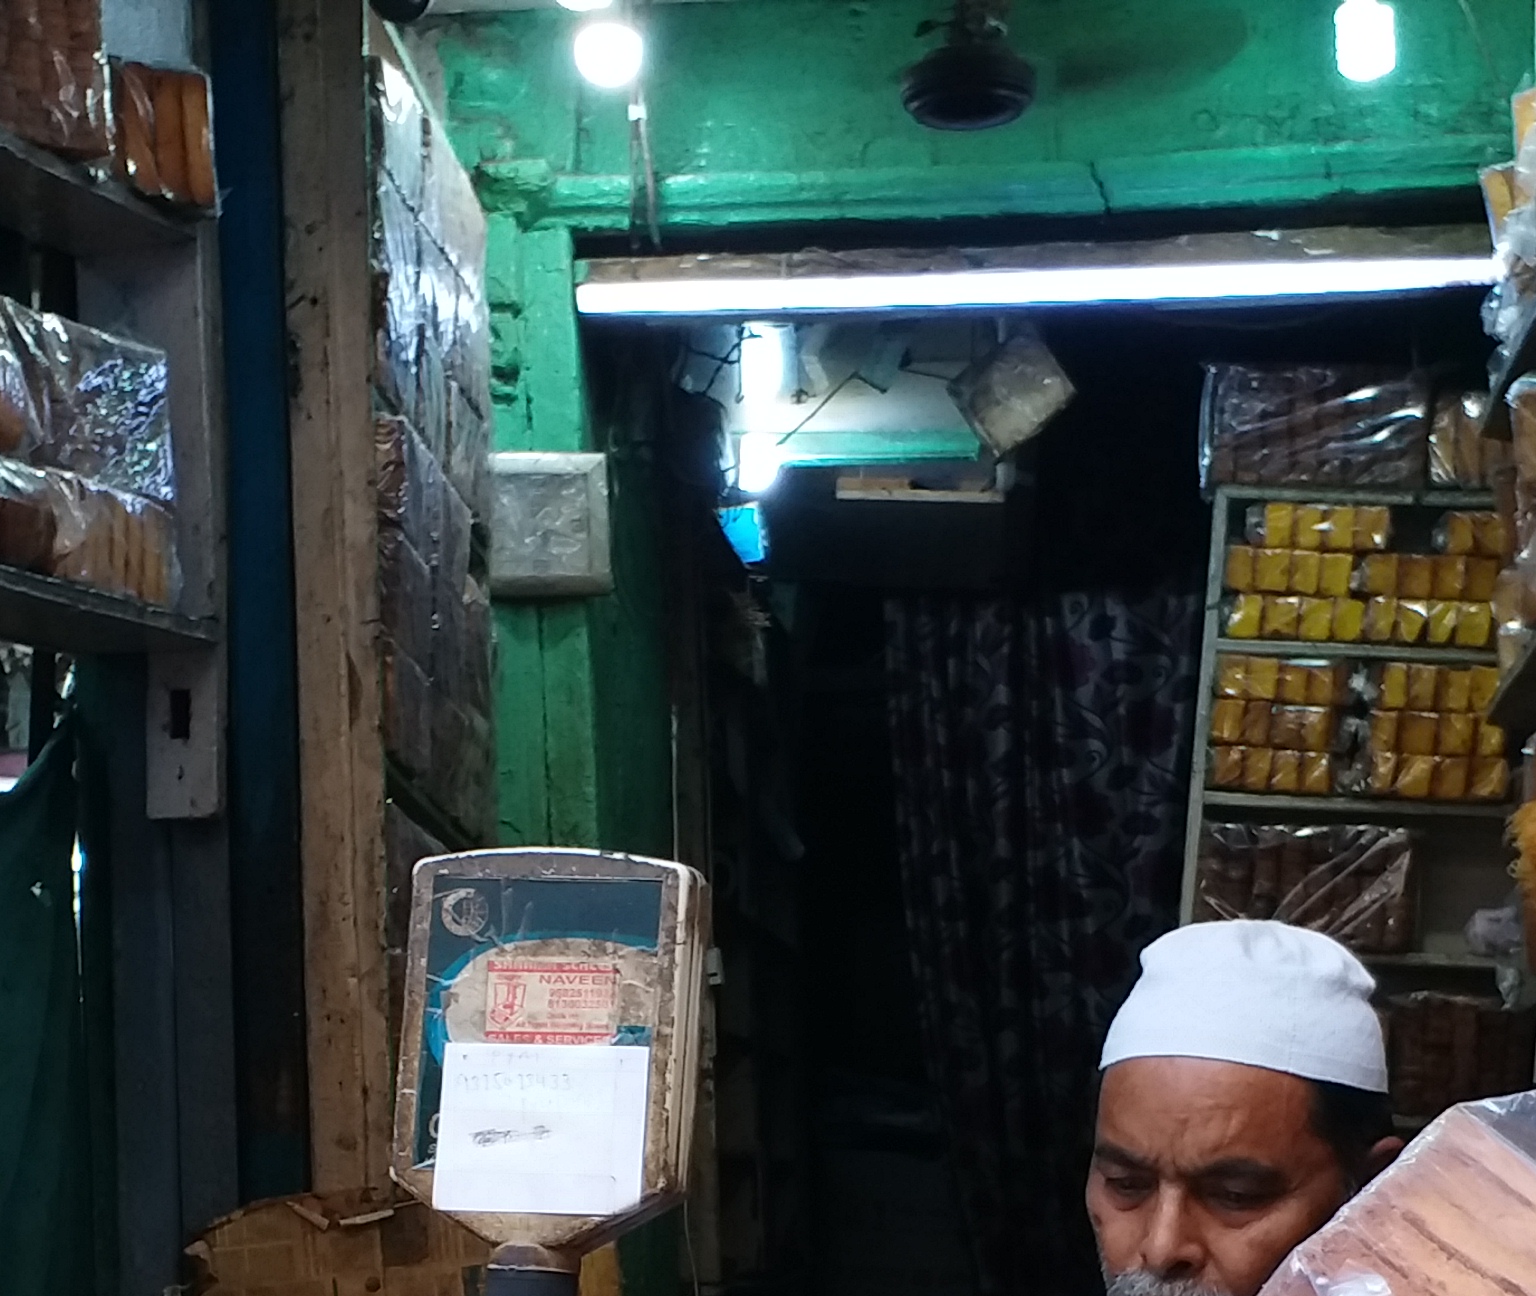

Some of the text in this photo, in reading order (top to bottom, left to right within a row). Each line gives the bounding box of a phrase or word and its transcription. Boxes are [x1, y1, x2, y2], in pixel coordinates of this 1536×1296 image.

[539, 974, 616, 986] NAVEEN
[487, 1033, 531, 1043] SALES
[533, 1033, 544, 1043] &
